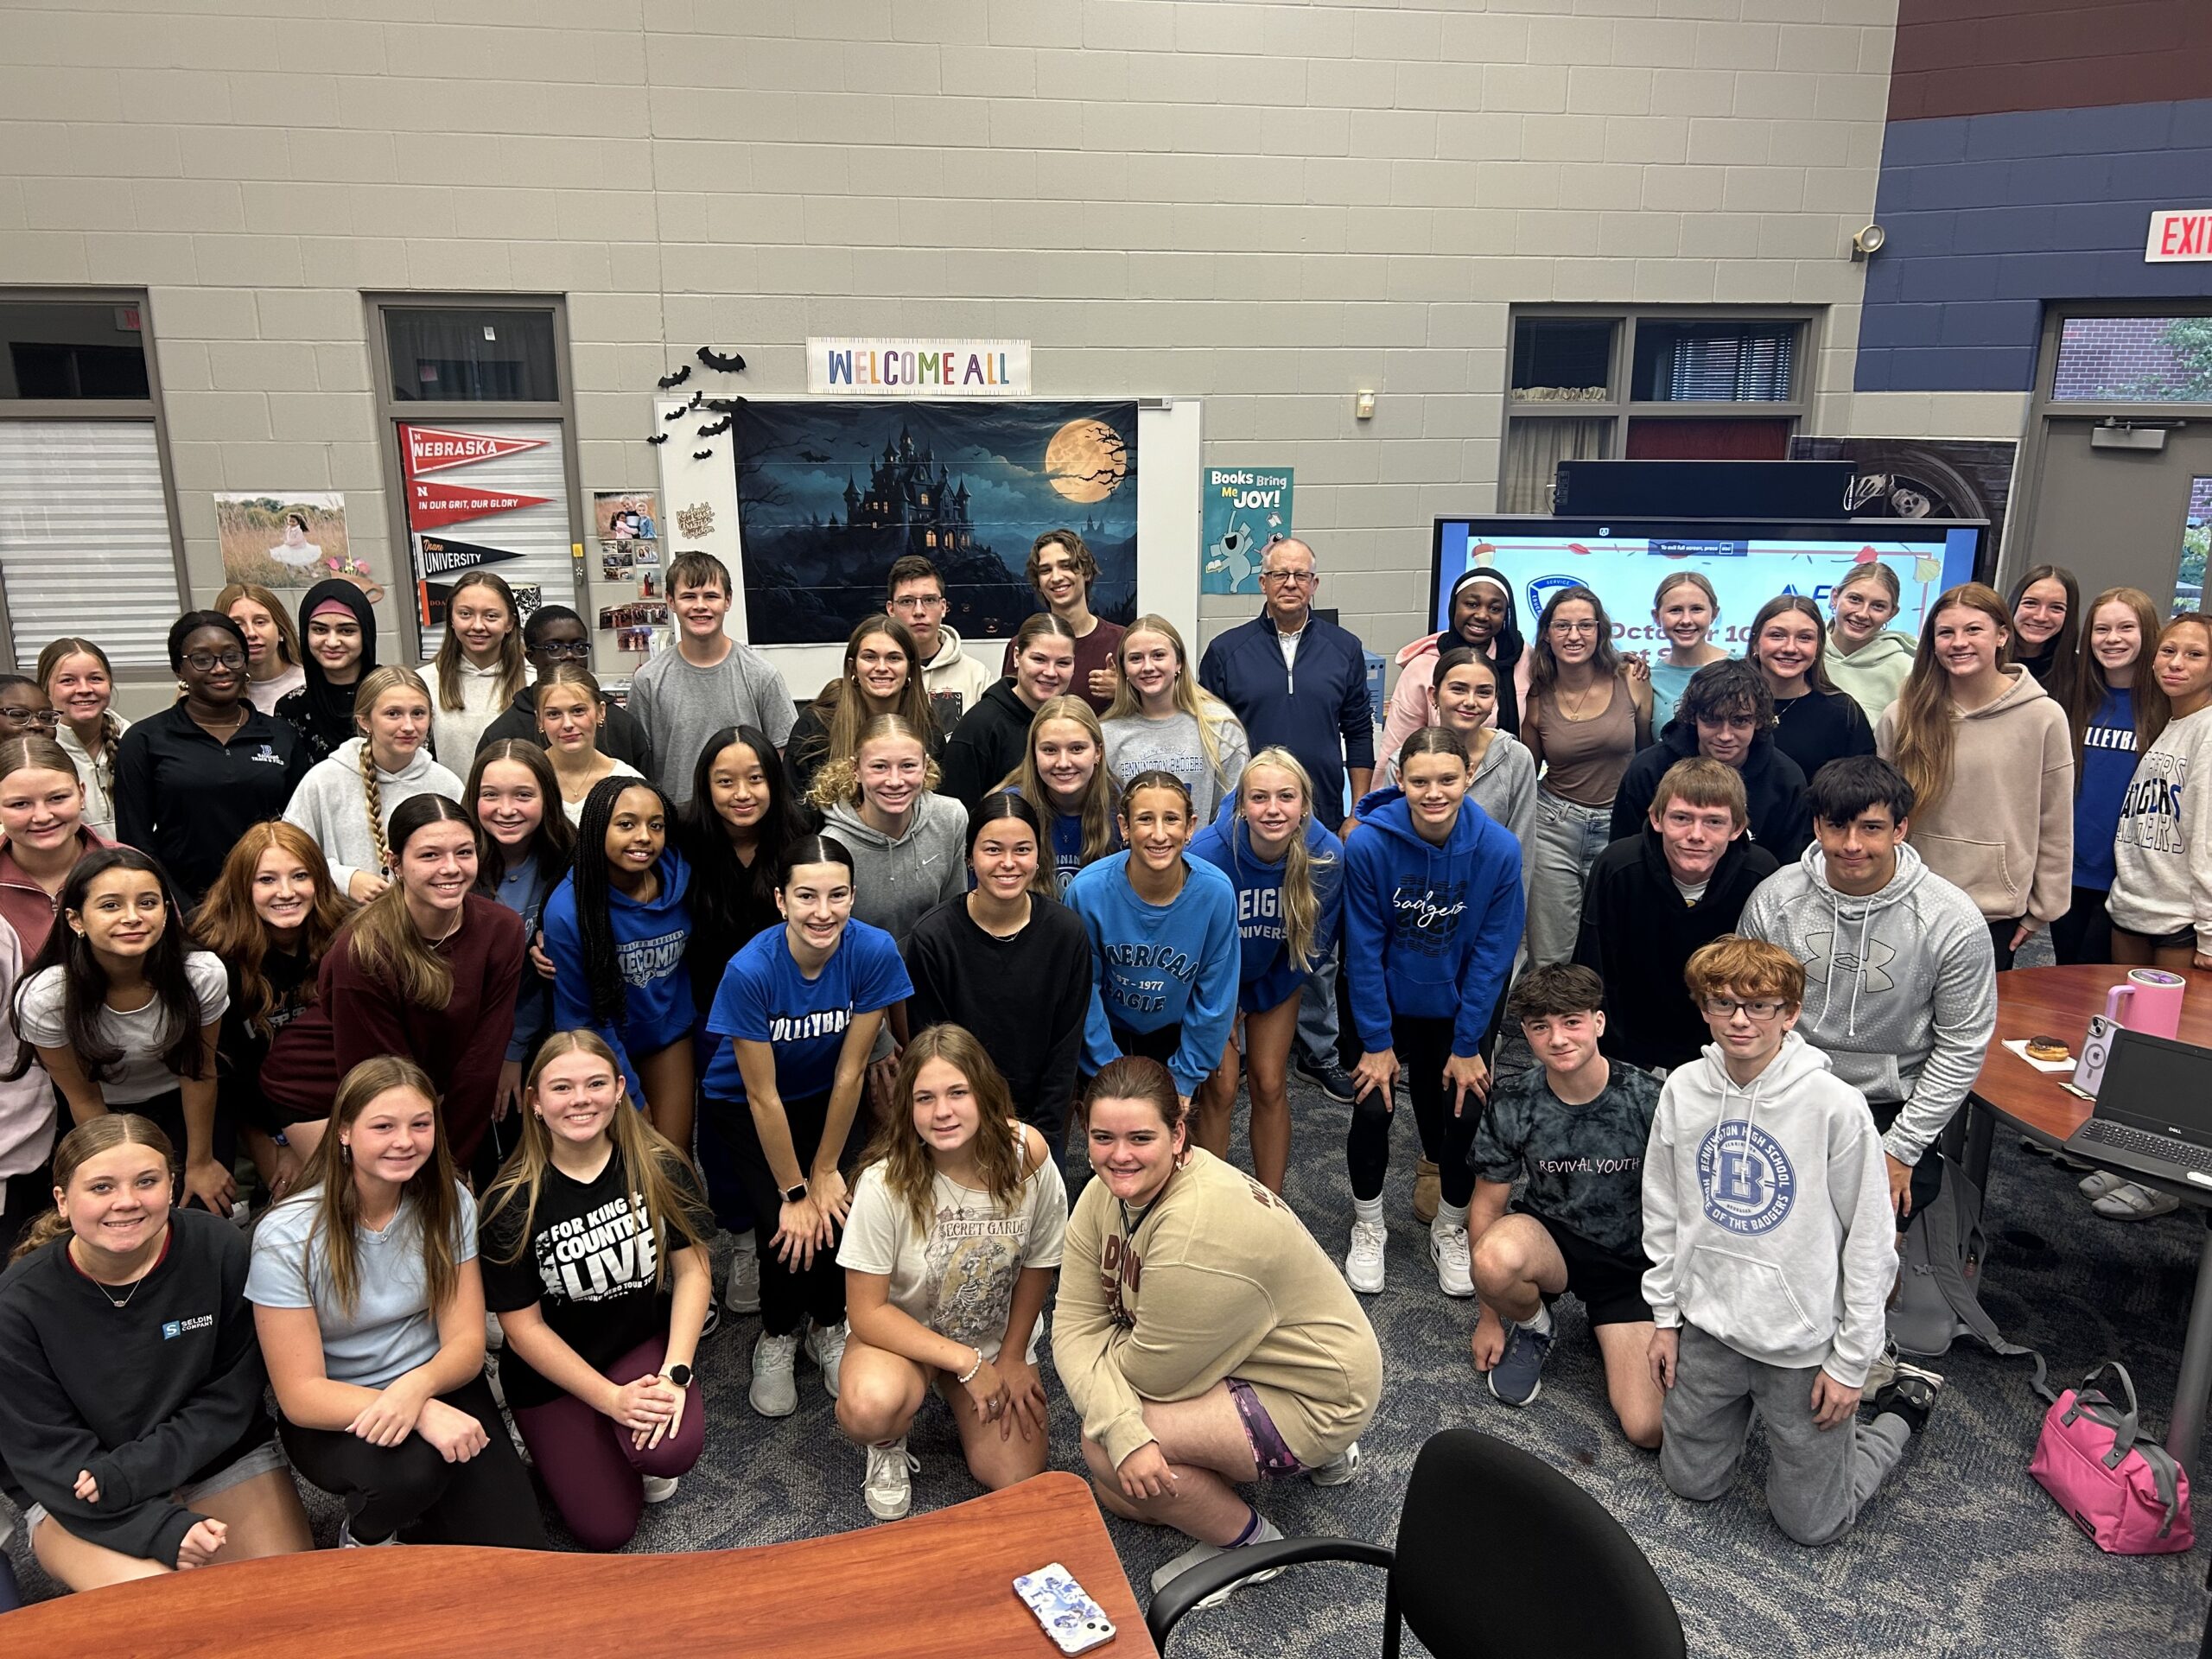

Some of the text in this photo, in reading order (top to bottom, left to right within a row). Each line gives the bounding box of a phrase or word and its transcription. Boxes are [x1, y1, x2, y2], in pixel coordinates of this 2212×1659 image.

[829, 350, 1010, 385] WELCOME ALL
[414, 441, 498, 457] NEBRASKA
[1211, 470, 1287, 490] Books Bring
[416, 486, 428, 497] N
[1222, 486, 1281, 509] Me JOY!
[418, 499, 518, 510] IN OUR GRIT, OUR GLORY
[424, 552, 481, 574] UNIVERSITY
[1611, 622, 1719, 642] Octor
[2084, 727, 2139, 752] LLEYBA
[1238, 925, 1288, 939] NIVERS
[1139, 981, 1164, 991] 1977
[1539, 1158, 1641, 1173] REVIVAL YOUTH
[1741, 1126, 1766, 1147] HGH
[1764, 1144, 1790, 1187] SCHOOL
[1713, 1148, 1764, 1207] B
[550, 1217, 586, 1242] FOR
[586, 1198, 628, 1228] KING
[1712, 1208, 1727, 1222] OF
[1729, 1217, 1750, 1231] THE
[1750, 1193, 1789, 1230] BADGERS
[556, 1205, 649, 1262] COUNTRY
[939, 1223, 984, 1239] SECRET
[560, 1227, 658, 1299] LIVE
[166, 1325, 177, 1335] S
[181, 1314, 213, 1326] SELDIN
[181, 1320, 213, 1331] COMPANY
